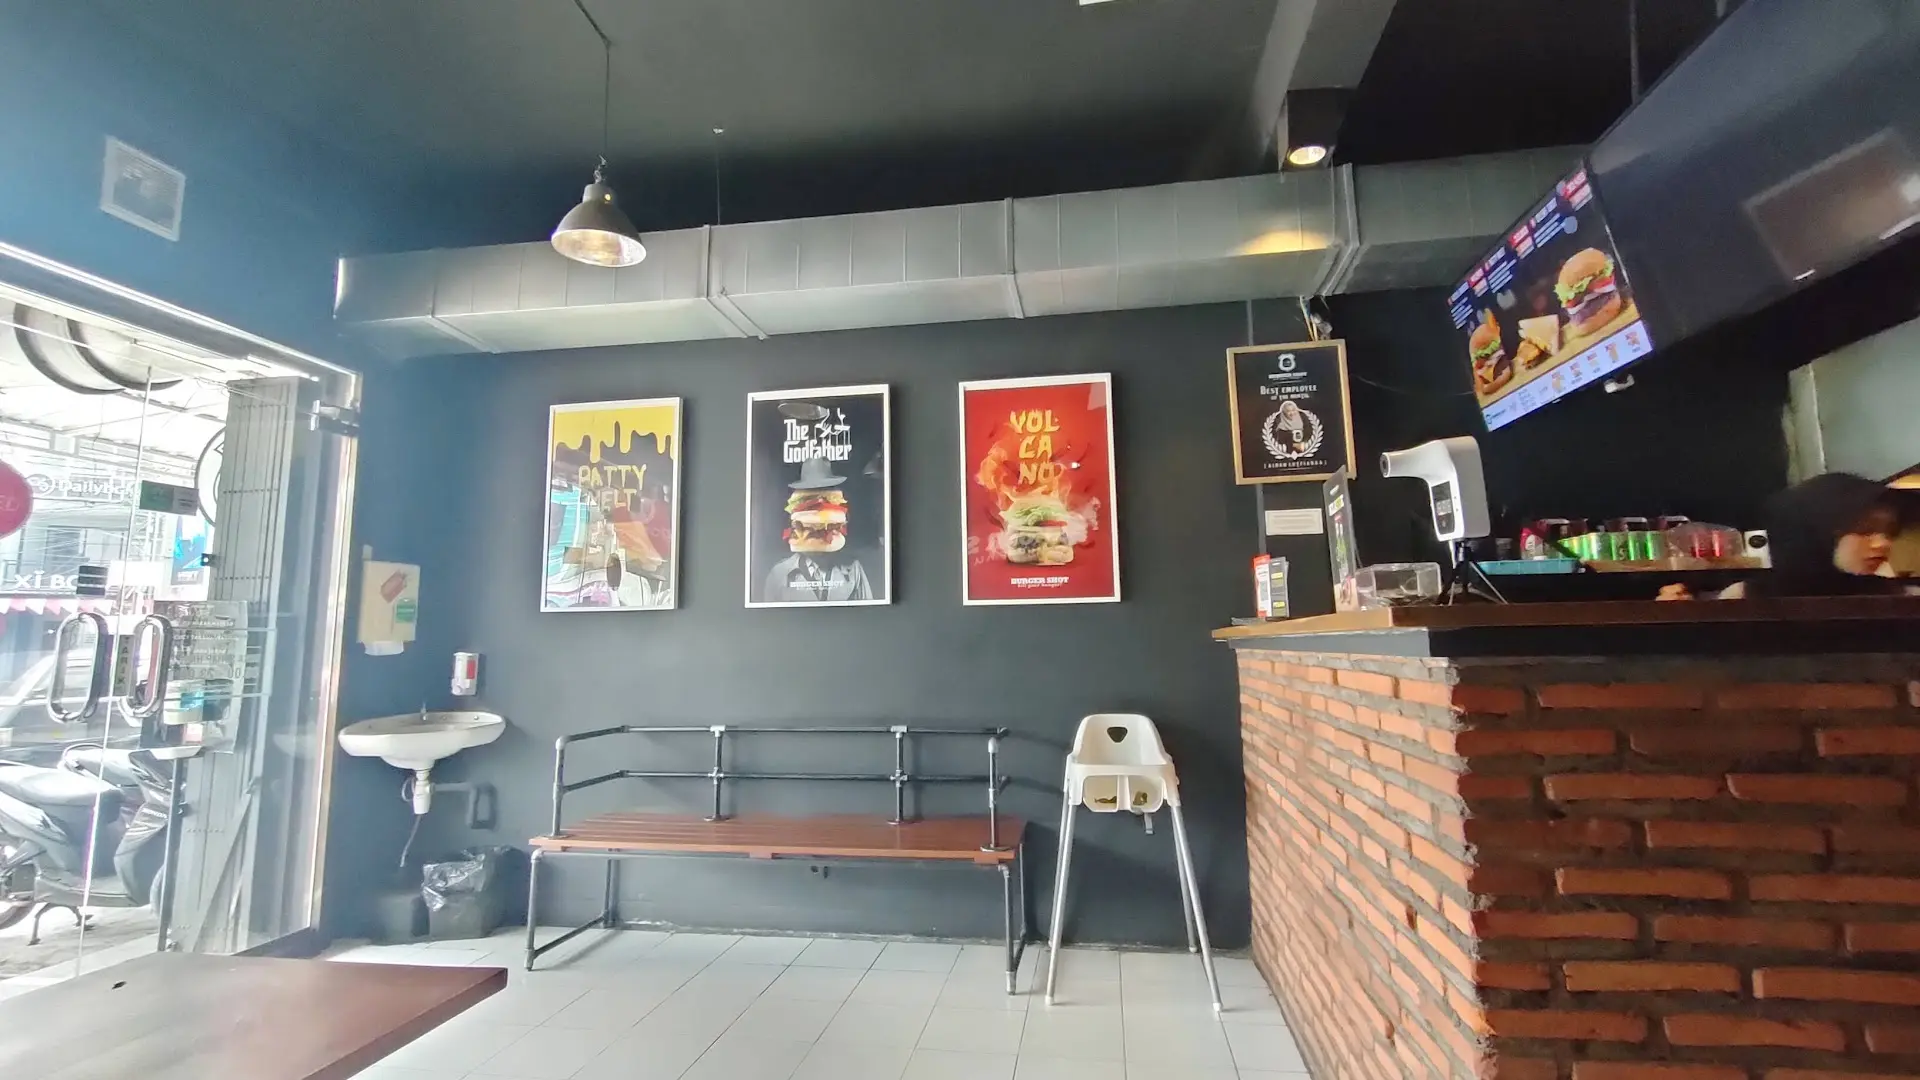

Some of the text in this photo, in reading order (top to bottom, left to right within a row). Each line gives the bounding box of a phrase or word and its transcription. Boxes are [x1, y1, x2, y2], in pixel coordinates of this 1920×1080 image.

[784, 418, 810, 440] The
[1010, 409, 1061, 433] VOL
[784, 440, 852, 463] Godfather
[578, 463, 647, 491] PATTY
[1010, 576, 1070, 585] BURGER SHOT
